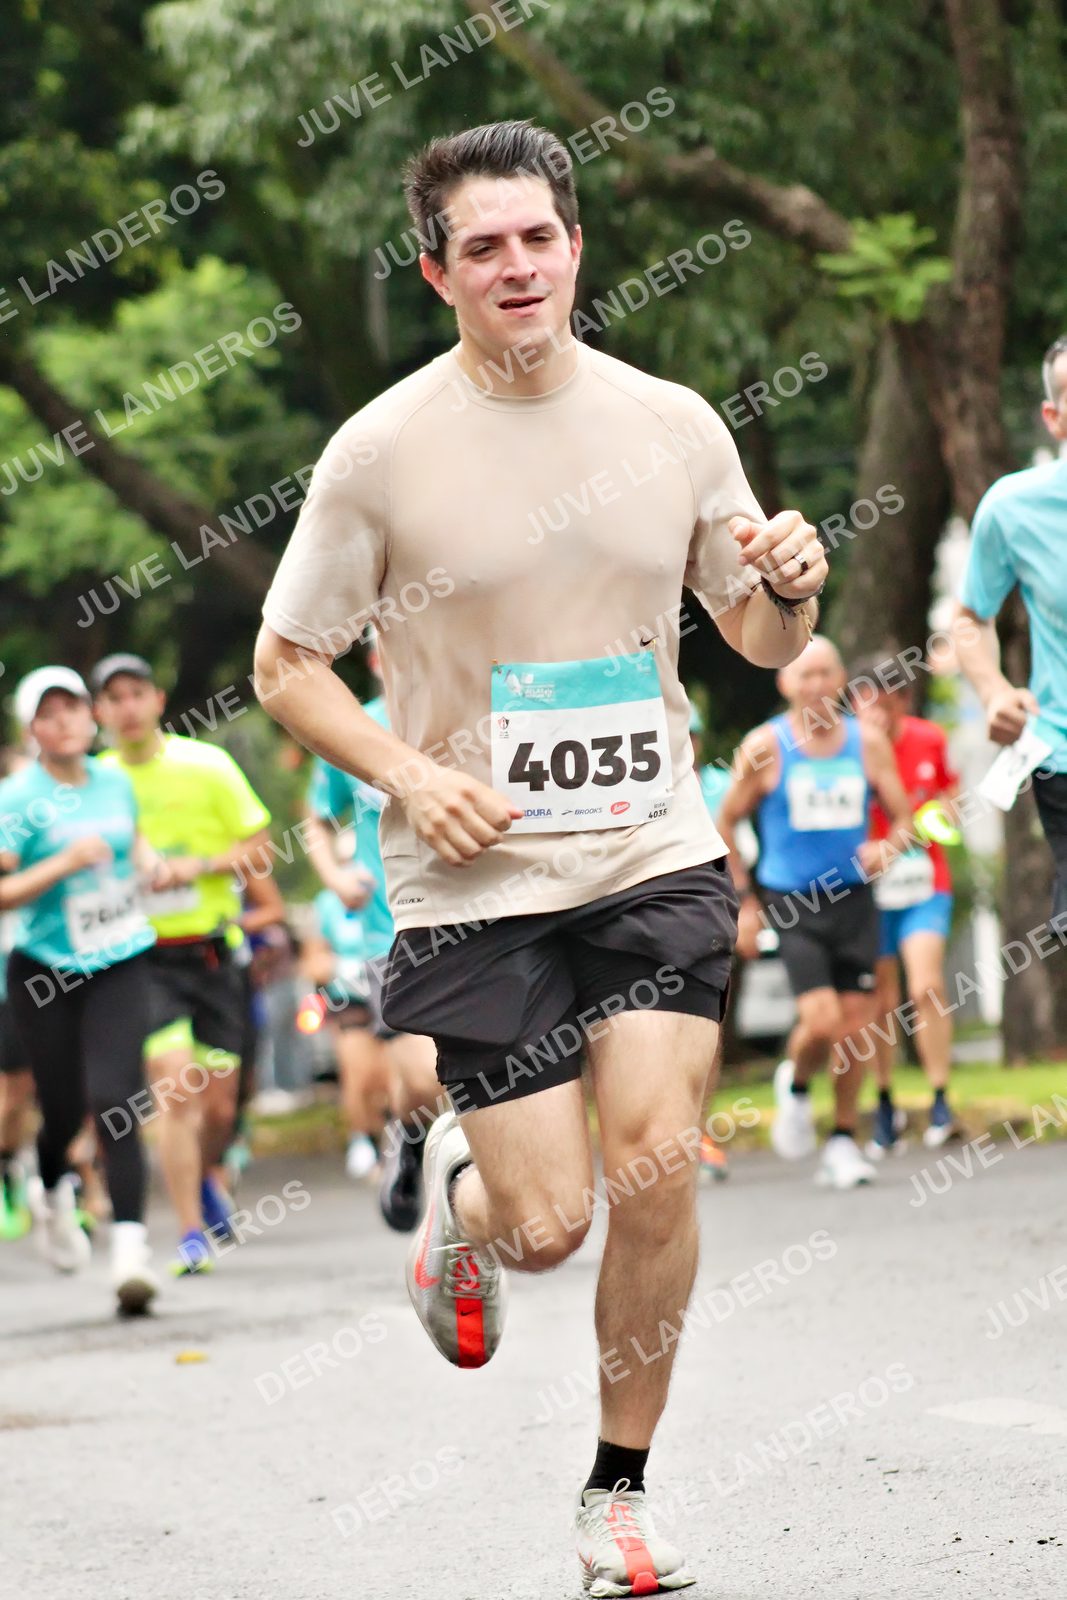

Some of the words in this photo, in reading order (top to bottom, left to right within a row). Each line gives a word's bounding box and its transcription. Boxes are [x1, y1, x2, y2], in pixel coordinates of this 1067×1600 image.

[508, 730, 661, 792] 4035
[574, 807, 603, 816] BROOKS
[648, 808, 668, 819] 4035
